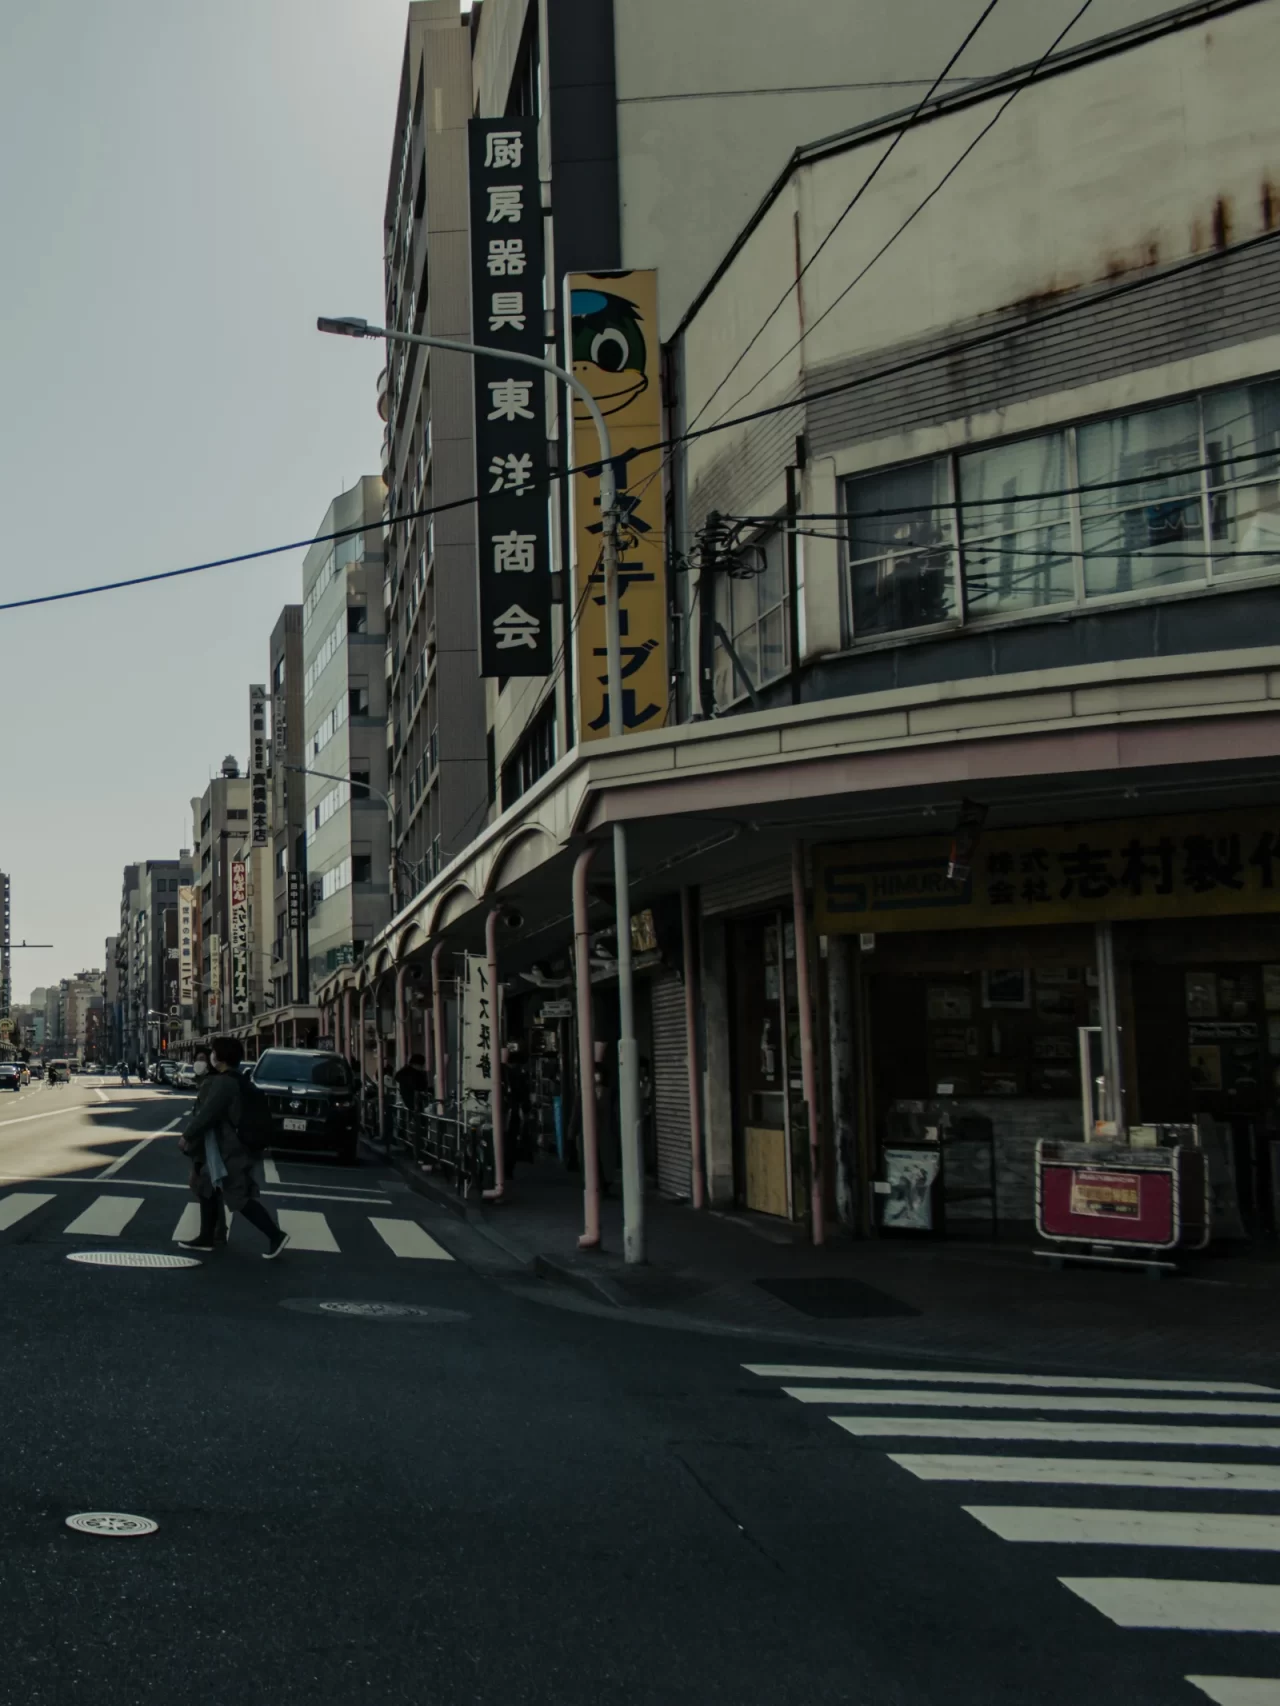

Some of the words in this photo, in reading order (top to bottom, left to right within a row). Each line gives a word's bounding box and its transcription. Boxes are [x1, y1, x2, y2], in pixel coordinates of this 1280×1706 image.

[484, 129, 528, 333] 厨房器具
[487, 377, 542, 652] 東洋商会
[987, 847, 1050, 876] 株式
[987, 879, 1051, 905] 会社
[181, 962, 192, 998] ニイミ
